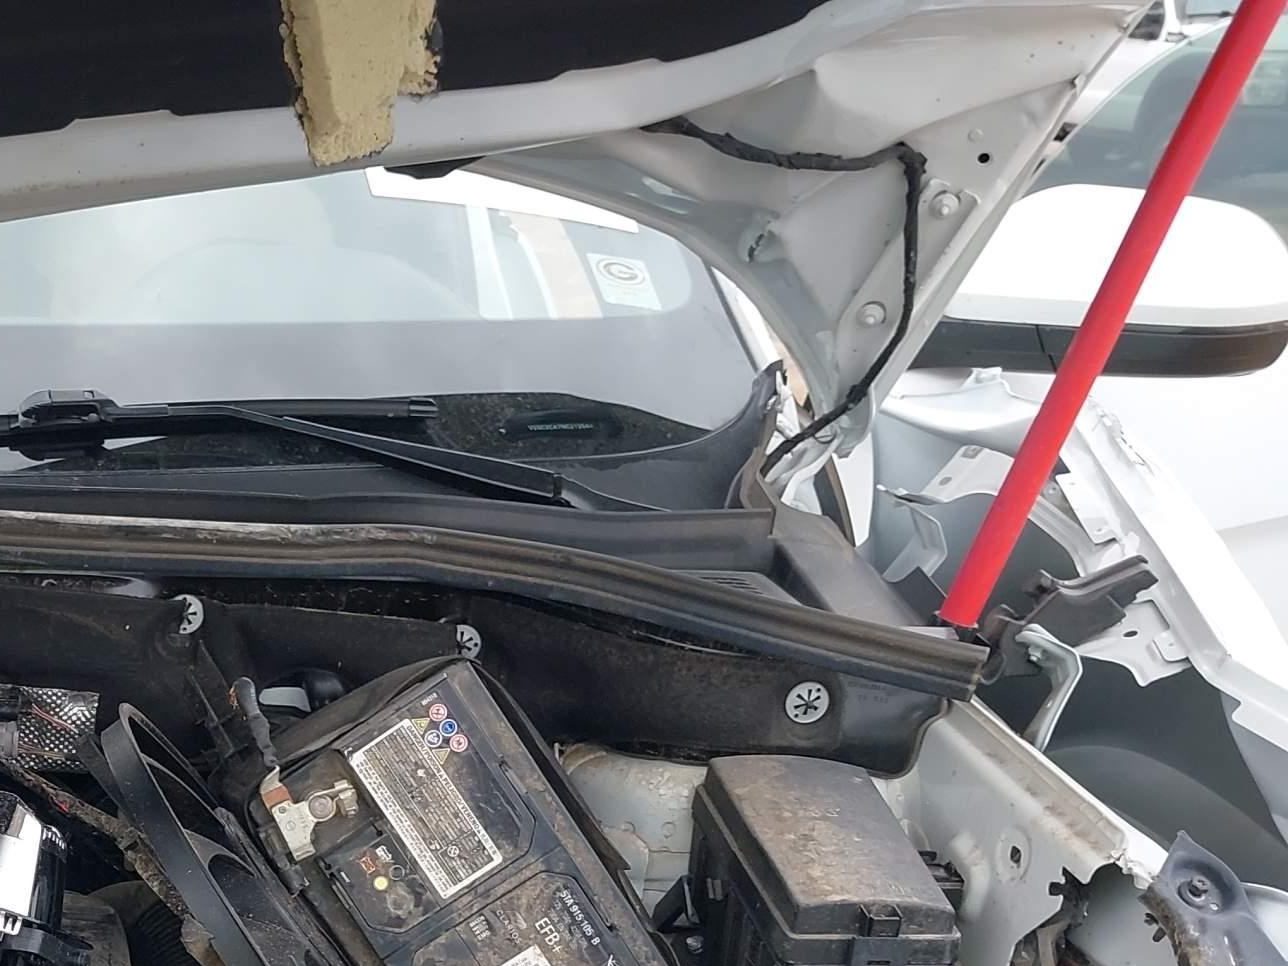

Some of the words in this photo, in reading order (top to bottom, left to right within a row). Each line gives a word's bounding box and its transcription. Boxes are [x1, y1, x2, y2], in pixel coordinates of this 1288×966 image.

[495, 907, 522, 945] CLARIOS
[533, 915, 566, 956] EFB+
[558, 889, 574, 907] 5TA
[568, 903, 584, 922] 915
[579, 920, 594, 937] 105
[590, 936, 601, 946] B
